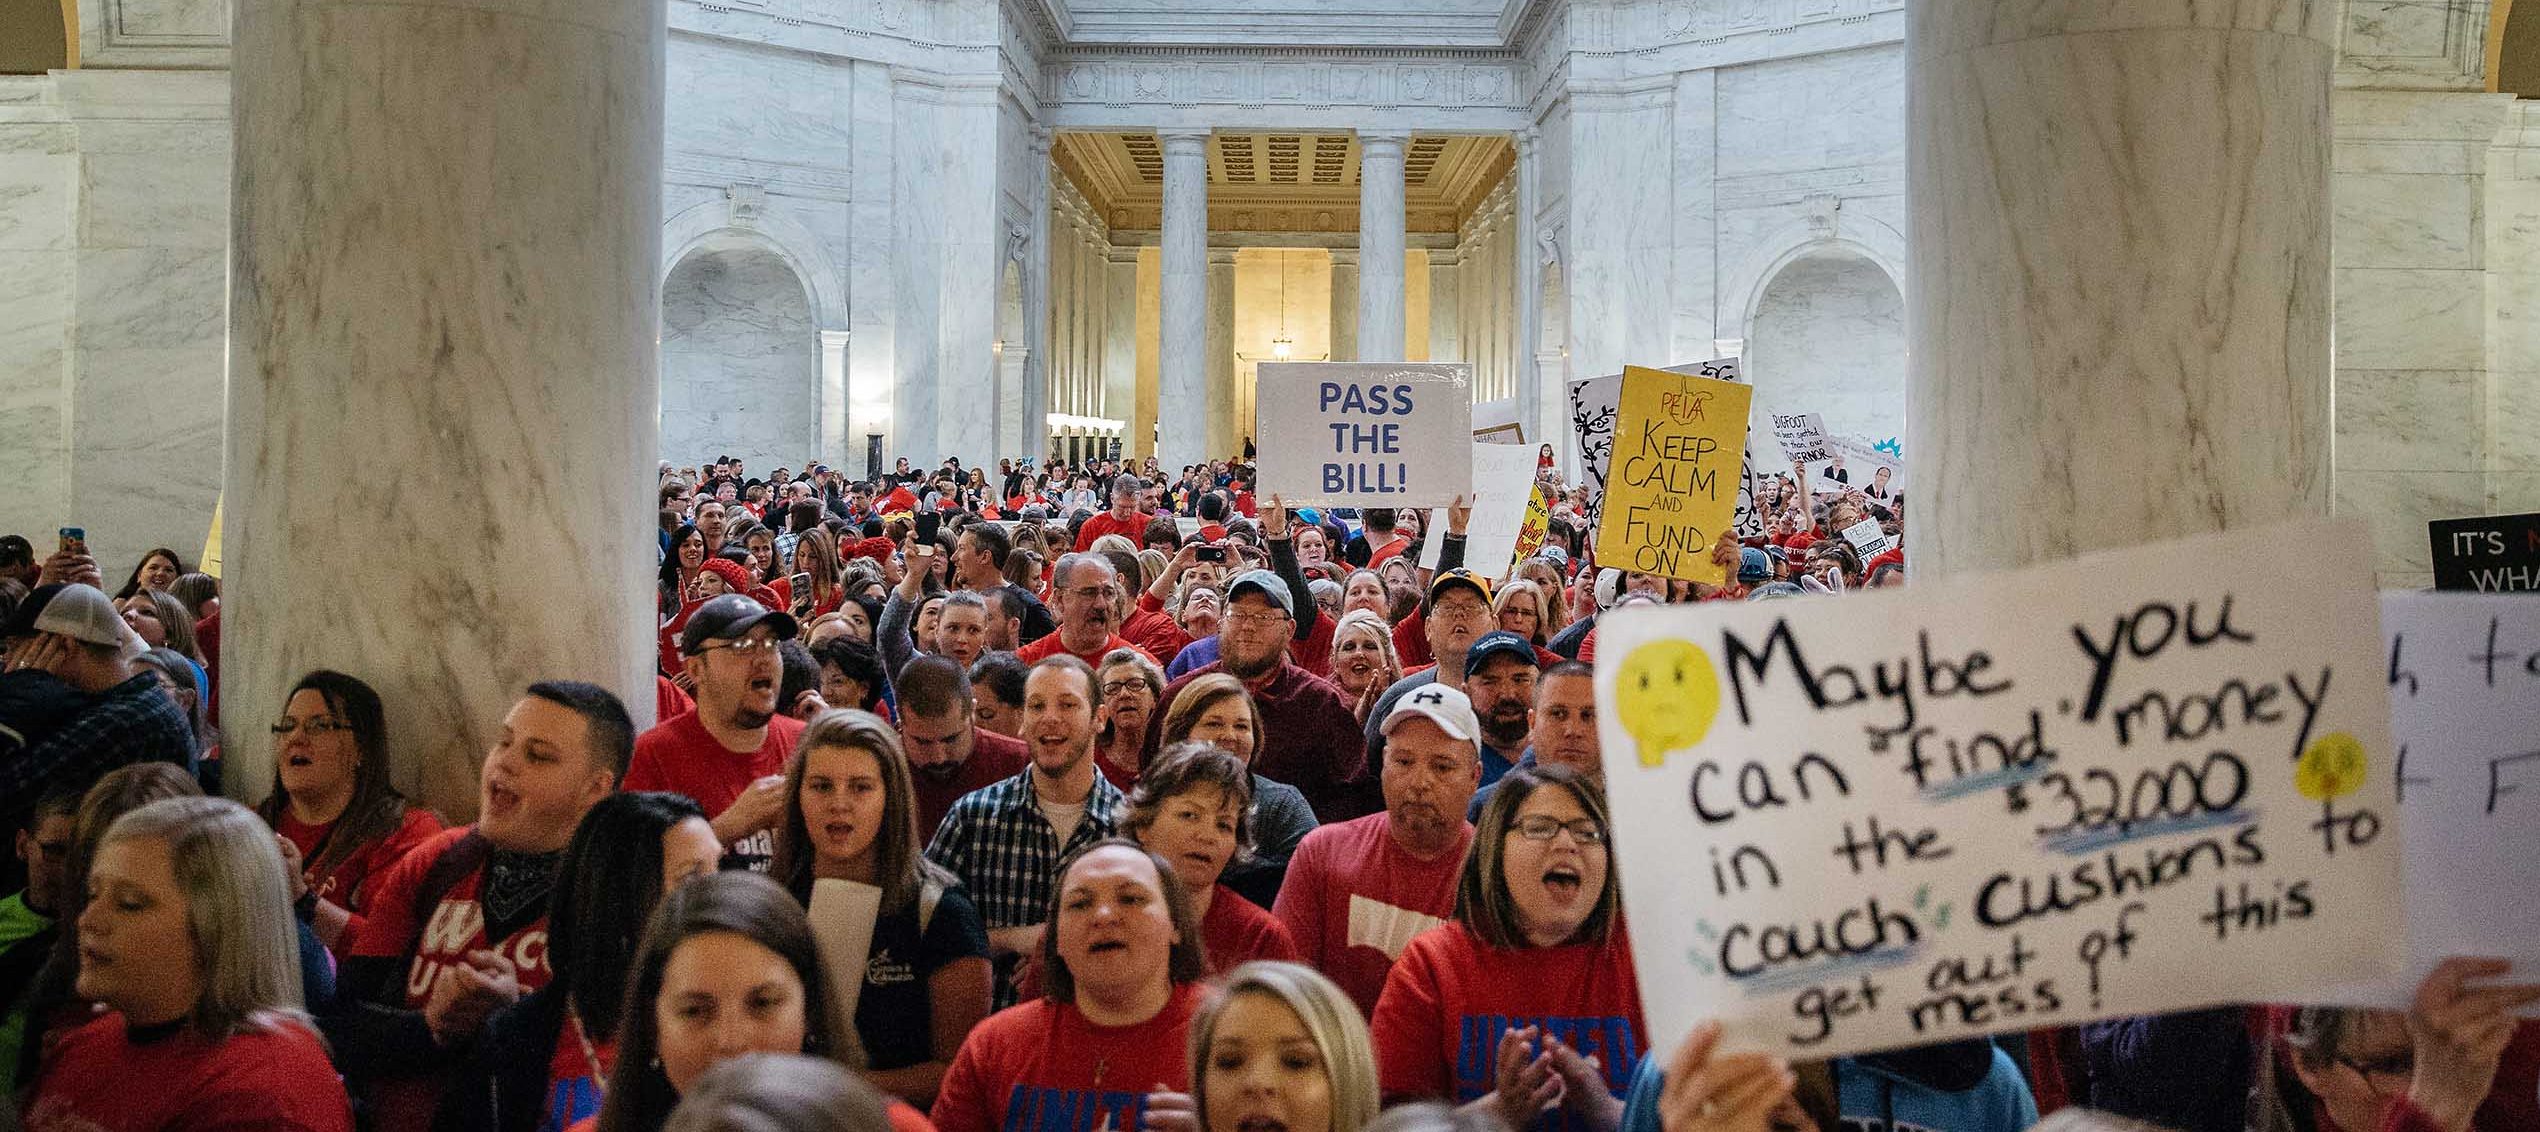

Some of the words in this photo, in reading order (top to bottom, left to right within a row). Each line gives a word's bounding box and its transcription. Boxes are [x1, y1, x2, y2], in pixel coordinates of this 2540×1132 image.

[1320, 382, 1404, 415] PASS
[1661, 392, 1705, 422] PEIA
[1772, 414, 1806, 429] BIGFOOT
[1329, 423, 1399, 454] THE
[1642, 418, 1717, 464] KEEP
[1809, 439, 1823, 447] our
[1322, 462, 1406, 493] BILL!
[1624, 456, 1716, 501] CALM
[1650, 493, 1683, 513] AND
[1625, 505, 1705, 554] FUND
[2453, 531, 2506, 557] IT'S
[1635, 545, 1680, 576] ON
[1722, 617, 2013, 735] Maybe
[2071, 591, 2256, 722] you
[1689, 752, 1851, 824] can
[2113, 662, 2331, 760] money
[2312, 797, 2381, 855] to
[1708, 845, 1782, 896] in
[1832, 815, 1954, 875] the
[1786, 975, 1883, 1047] get
[1925, 935, 2036, 992] out
[2079, 901, 2145, 966] of
[2201, 879, 2315, 942] this
